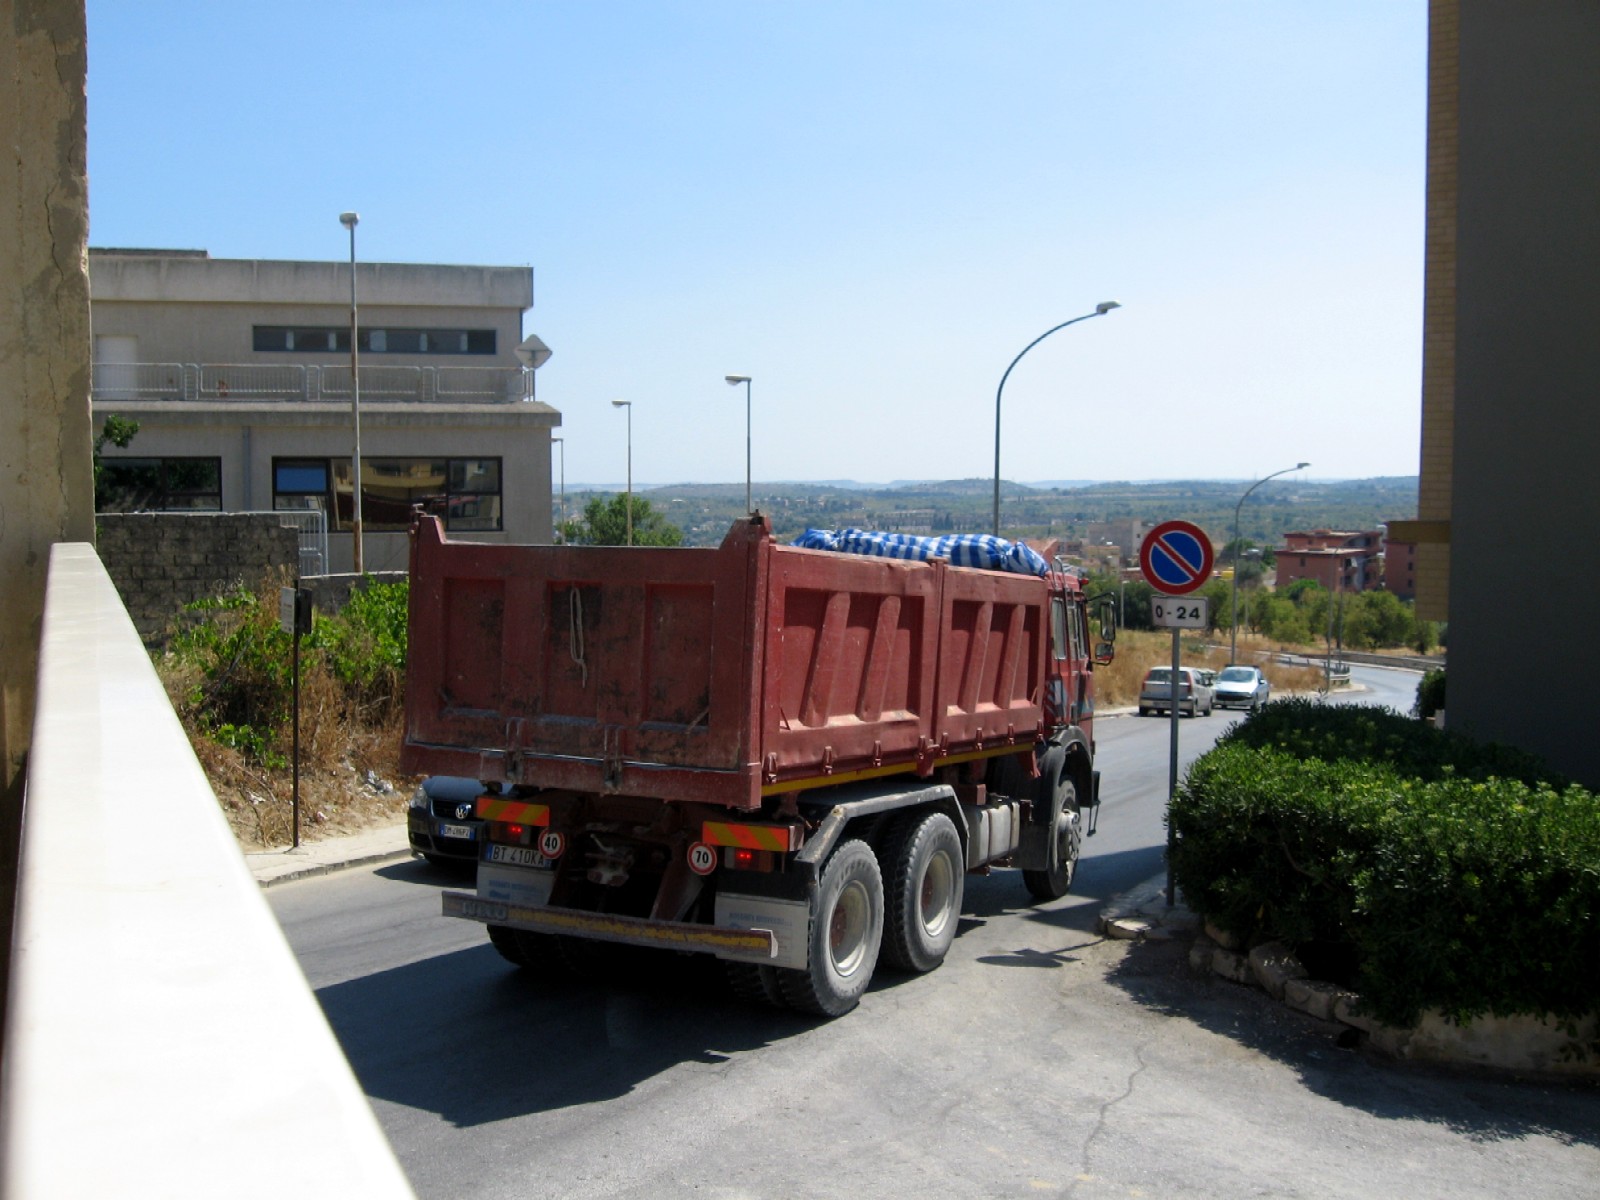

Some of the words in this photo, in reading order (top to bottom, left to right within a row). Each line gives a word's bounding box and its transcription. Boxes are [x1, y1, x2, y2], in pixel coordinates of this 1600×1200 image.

[544, 836, 557, 850] 40
[493, 846, 506, 860] BT
[695, 850, 709, 864] 70
